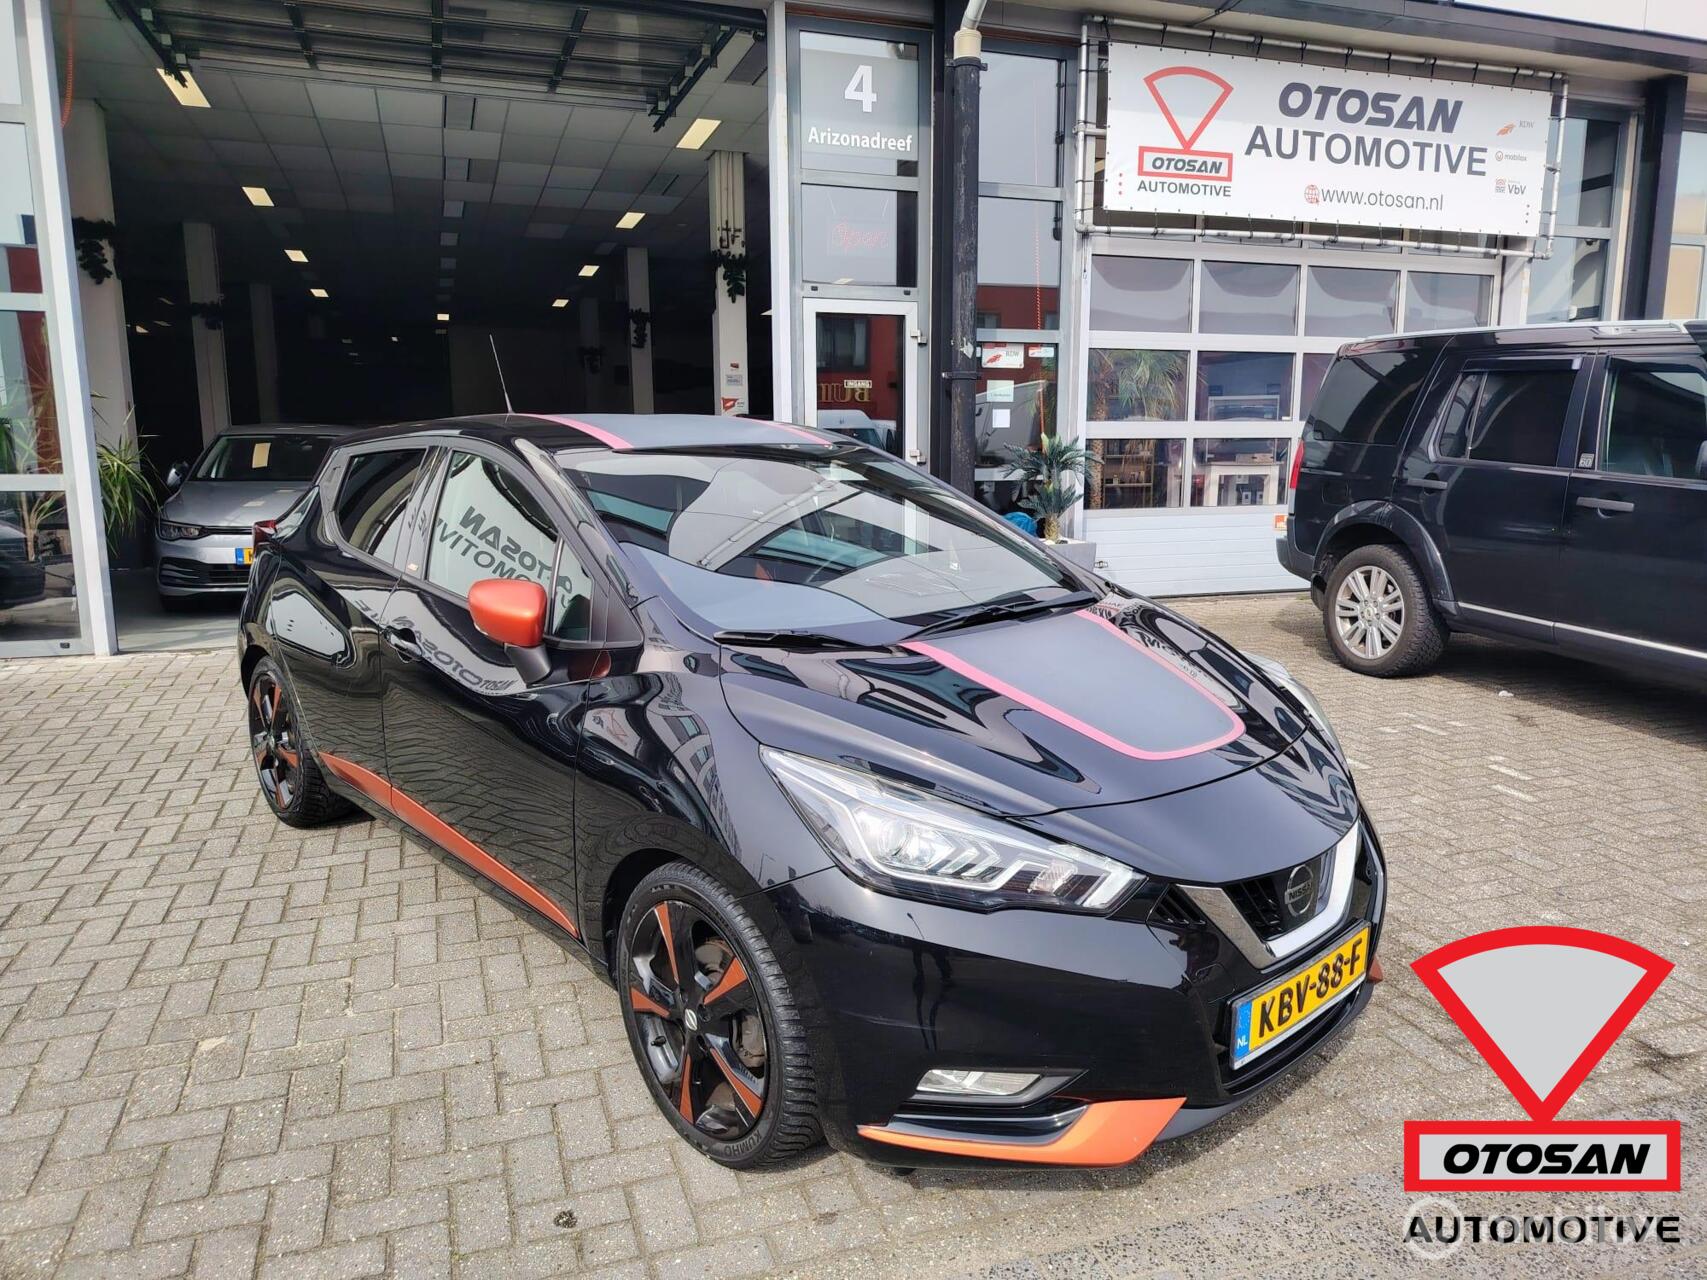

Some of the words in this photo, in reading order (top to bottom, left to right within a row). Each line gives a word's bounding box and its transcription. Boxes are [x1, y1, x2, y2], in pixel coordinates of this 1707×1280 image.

[844, 65, 877, 112] 4
[1278, 82, 1464, 134] OTOSAN
[808, 126, 912, 152] Arizonadreef
[1244, 124, 1488, 177] AUTOMOTIVE
[1152, 157, 1223, 174] OTOSAN
[1137, 180, 1231, 197] AUTOMOTIVE
[1321, 188, 1443, 211] www.otosan.nl
[1508, 184, 1526, 195] VbV
[1259, 938, 1362, 1037] KBV-88-F
[1237, 1035, 1248, 1048] NL
